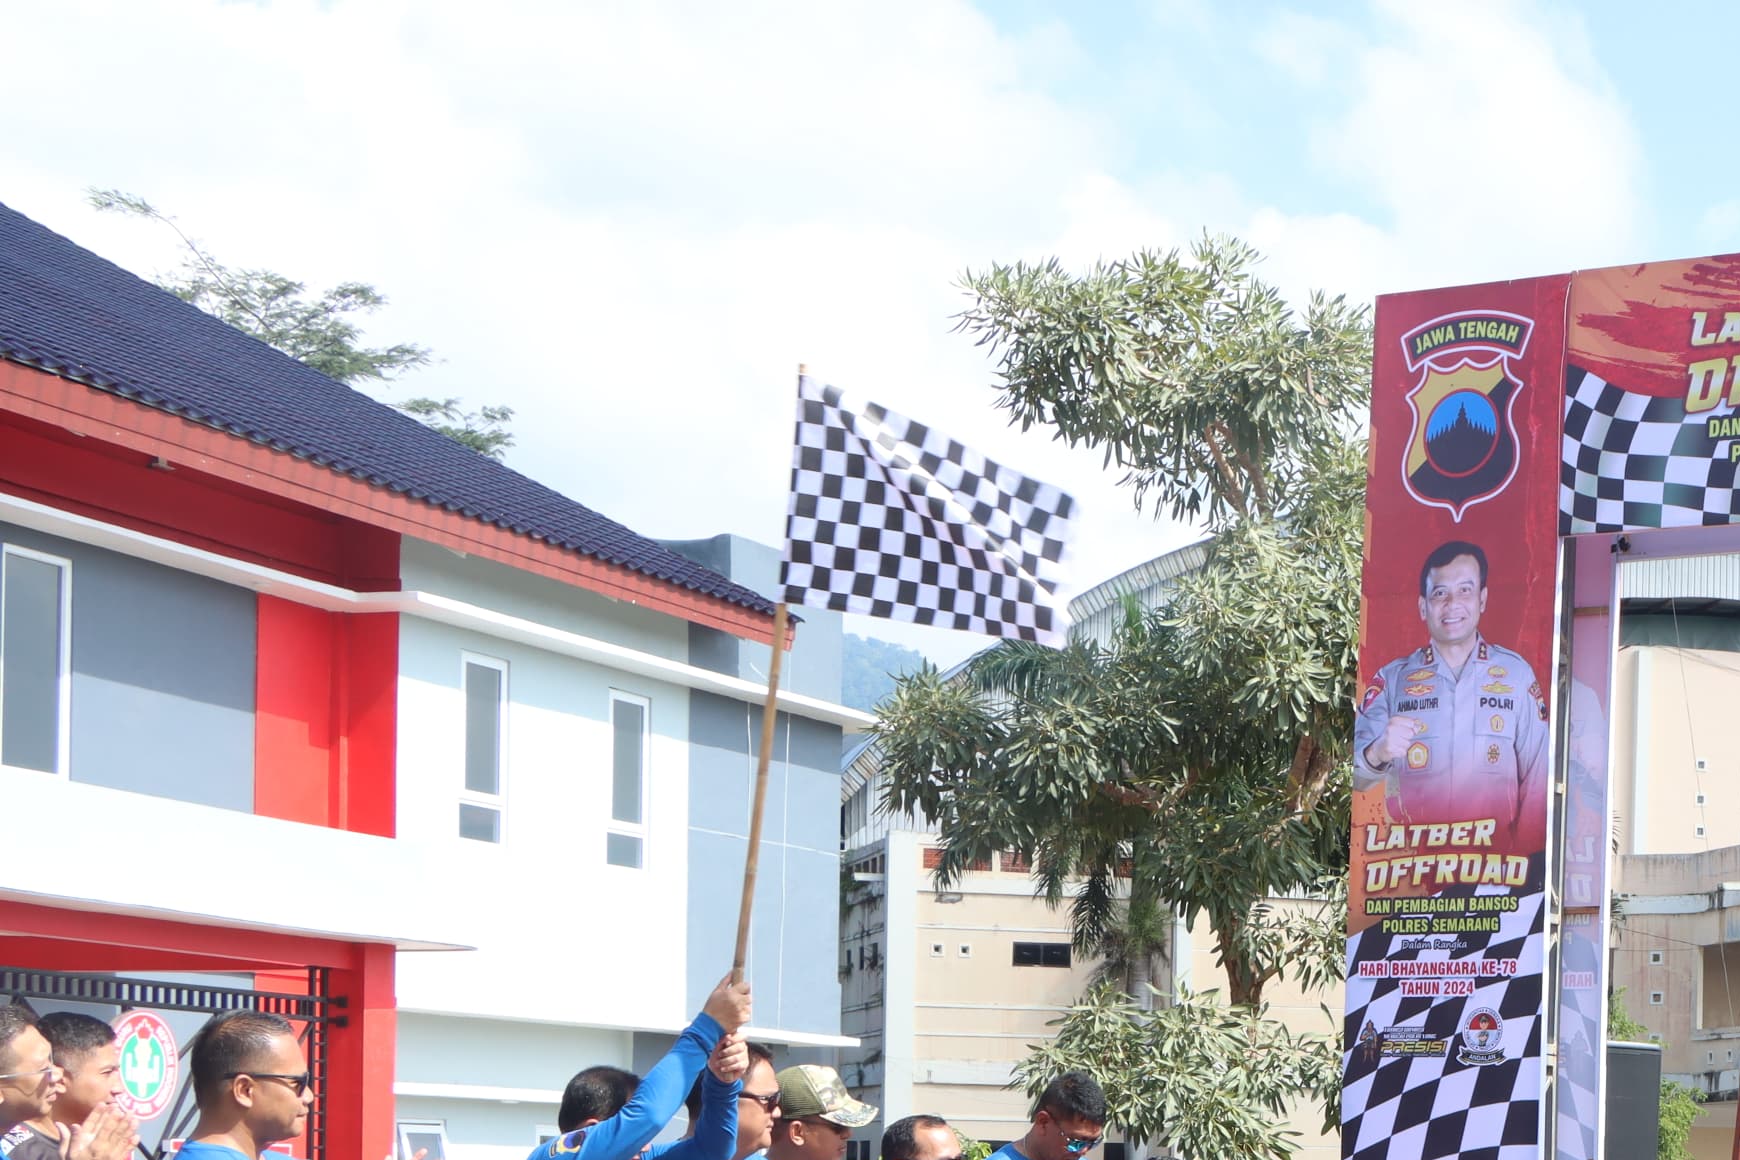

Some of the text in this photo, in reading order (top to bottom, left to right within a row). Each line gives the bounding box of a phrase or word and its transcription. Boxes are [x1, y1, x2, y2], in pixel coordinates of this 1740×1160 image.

[1416, 321, 1520, 354] JAWA TENGAH
[1480, 697, 1513, 711] POLRI
[1366, 819, 1497, 852] LATBER
[1366, 853, 1529, 893] OFFROAD
[1366, 896, 1518, 914] DAN PEMBAGIAN BANSOS
[1382, 916, 1499, 934] POLRES SEMARANG
[1401, 939, 1468, 952] Dalam Rangka
[1360, 960, 1517, 977] HARI BHAYANGKARA KE-78
[1400, 980, 1475, 996] TAHUN 2024
[1381, 1040, 1447, 1053] PRESISI
